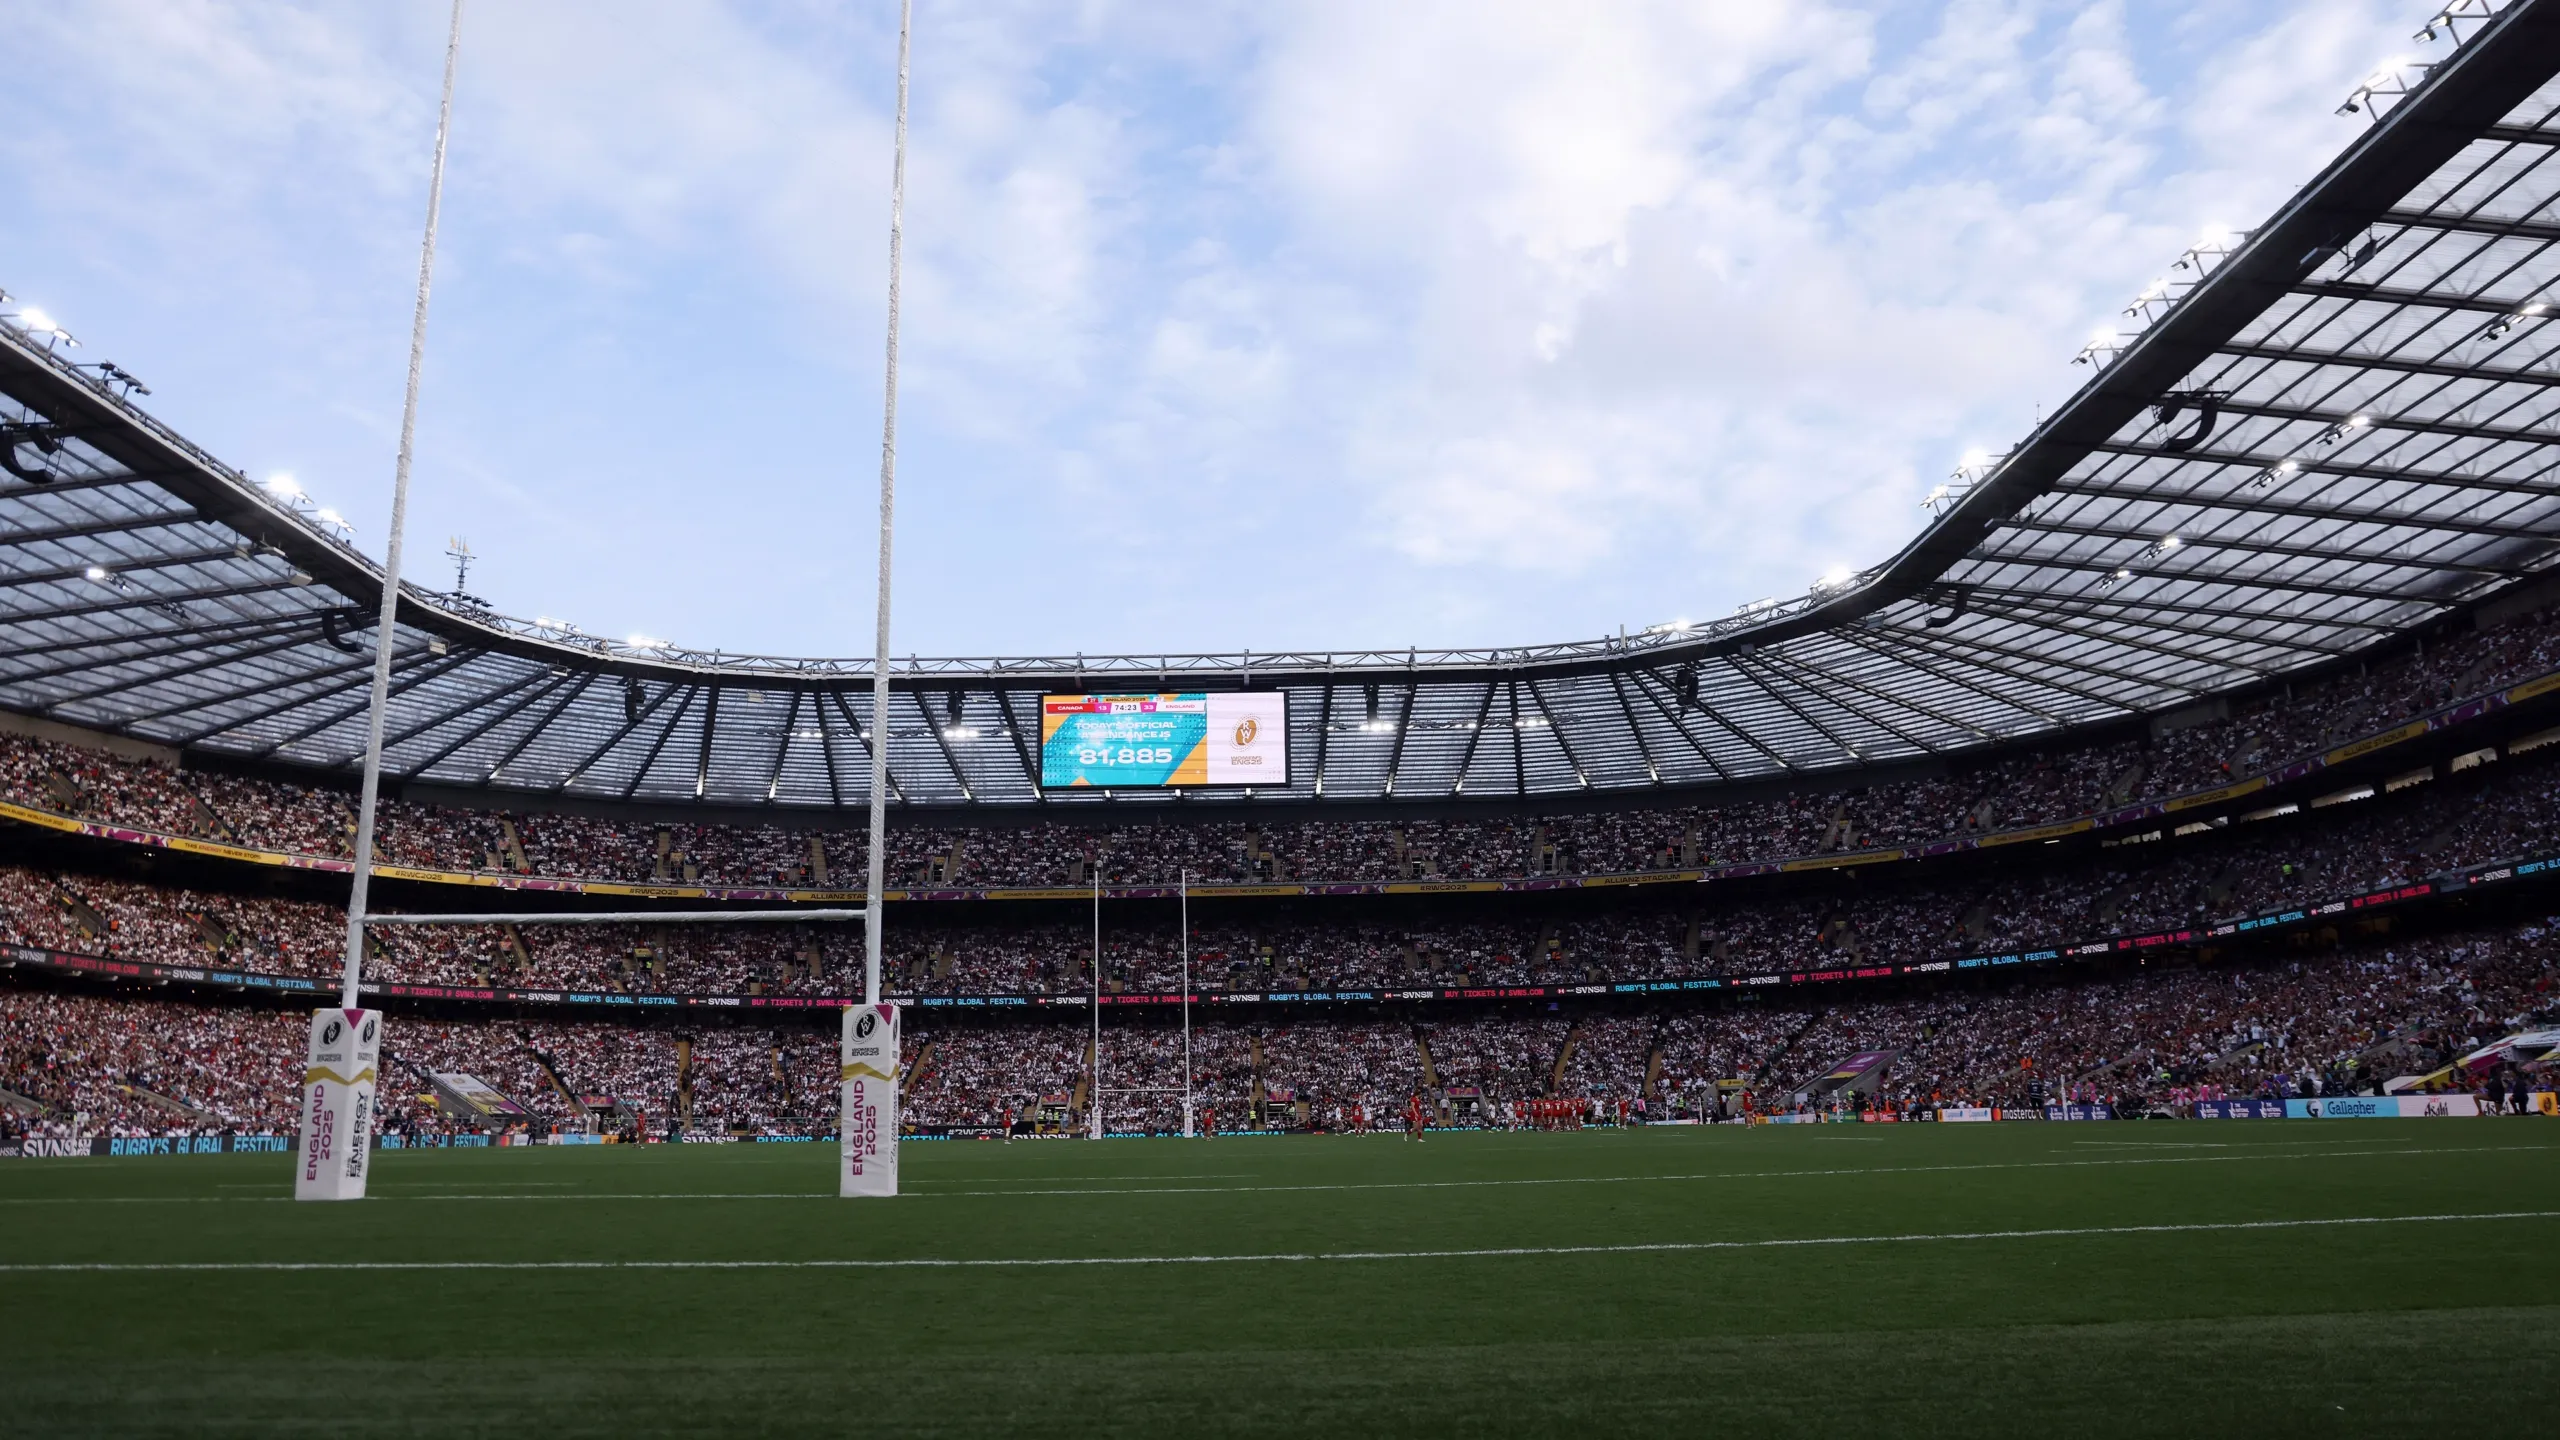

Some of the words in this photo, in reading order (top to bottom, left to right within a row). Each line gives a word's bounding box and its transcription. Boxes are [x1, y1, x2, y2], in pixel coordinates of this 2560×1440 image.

[1124, 721, 1177, 729] OFFICIAL
[1079, 748, 1172, 766] 81,885
[184, 842, 198, 850] THIS
[223, 848, 243, 856] NEVER
[2516, 861, 2546, 875] RUGBY'S
[395, 869, 443, 881] #RWC2025
[1641, 874, 1681, 882] STADIUM
[2484, 870, 2505, 882] SVNS
[629, 888, 678, 896] #RWC2025
[2238, 920, 2259, 931] RUGBY'S
[2259, 916, 2279, 927] GLOBAL
[2279, 911, 2305, 924] FESTIVAL
[2117, 940, 2132, 949] BUY
[2135, 935, 2166, 947] TICKETS
[2081, 944, 2102, 954] SVNS
[19, 949, 40, 962] SVNS
[1957, 957, 1989, 968] RUGBY'S
[1992, 955, 2021, 965] GLOBAL
[2024, 950, 2059, 961] FESTIVAL
[1920, 962, 1944, 971] SVNS
[172, 969, 197, 980] SVNS
[1749, 976, 1773, 985] SVNS
[1791, 974, 1806, 982] BUY
[1810, 972, 1844, 980] TICKETS
[212, 973, 242, 983] RUGBY'S
[245, 976, 272, 986] GLOBAL
[276, 979, 316, 989] FESTIVAL
[1615, 984, 1647, 992] RUGBY'S
[1650, 982, 1680, 991] GLOBAL
[1683, 980, 1721, 989] FESTIVAL
[391, 986, 407, 994] BUY
[410, 987, 444, 996] TICKETS
[527, 991, 551, 1001] SVNS
[1336, 992, 1374, 1000] FESTIVAL
[1402, 991, 1426, 999] SVNS
[1444, 990, 1459, 998] BUY
[1463, 989, 1496, 998] TICKETS
[1508, 988, 1544, 996] SVNS.COM
[1575, 986, 1599, 994] SVNS
[569, 994, 601, 1003] RUGBY'S
[605, 995, 634, 1003] GLOBAL
[638, 996, 678, 1004] FESTIVAL
[751, 998, 766, 1006] BUY
[770, 998, 804, 1006] TICKETS
[815, 999, 852, 1007] SVNS.COM
[883, 998, 907, 1006] SVNS
[989, 997, 1028, 1005] FESTIVAL
[1229, 994, 1252, 1002] SVNS
[2327, 1100, 2376, 1117] Gallagher
[2424, 1102, 2449, 1117] Asahi
[306, 1084, 325, 1181] ENGLAND
[349, 1090, 366, 1178] ENERGY
[852, 1080, 865, 1176] ENGLAND
[865, 1105, 877, 1156] 2025
[320, 1109, 334, 1160] 2025
[0, 1147, 19, 1157] HSBC
[22, 1138, 74, 1157] SVNS
[110, 1137, 171, 1156] RUGBY'S
